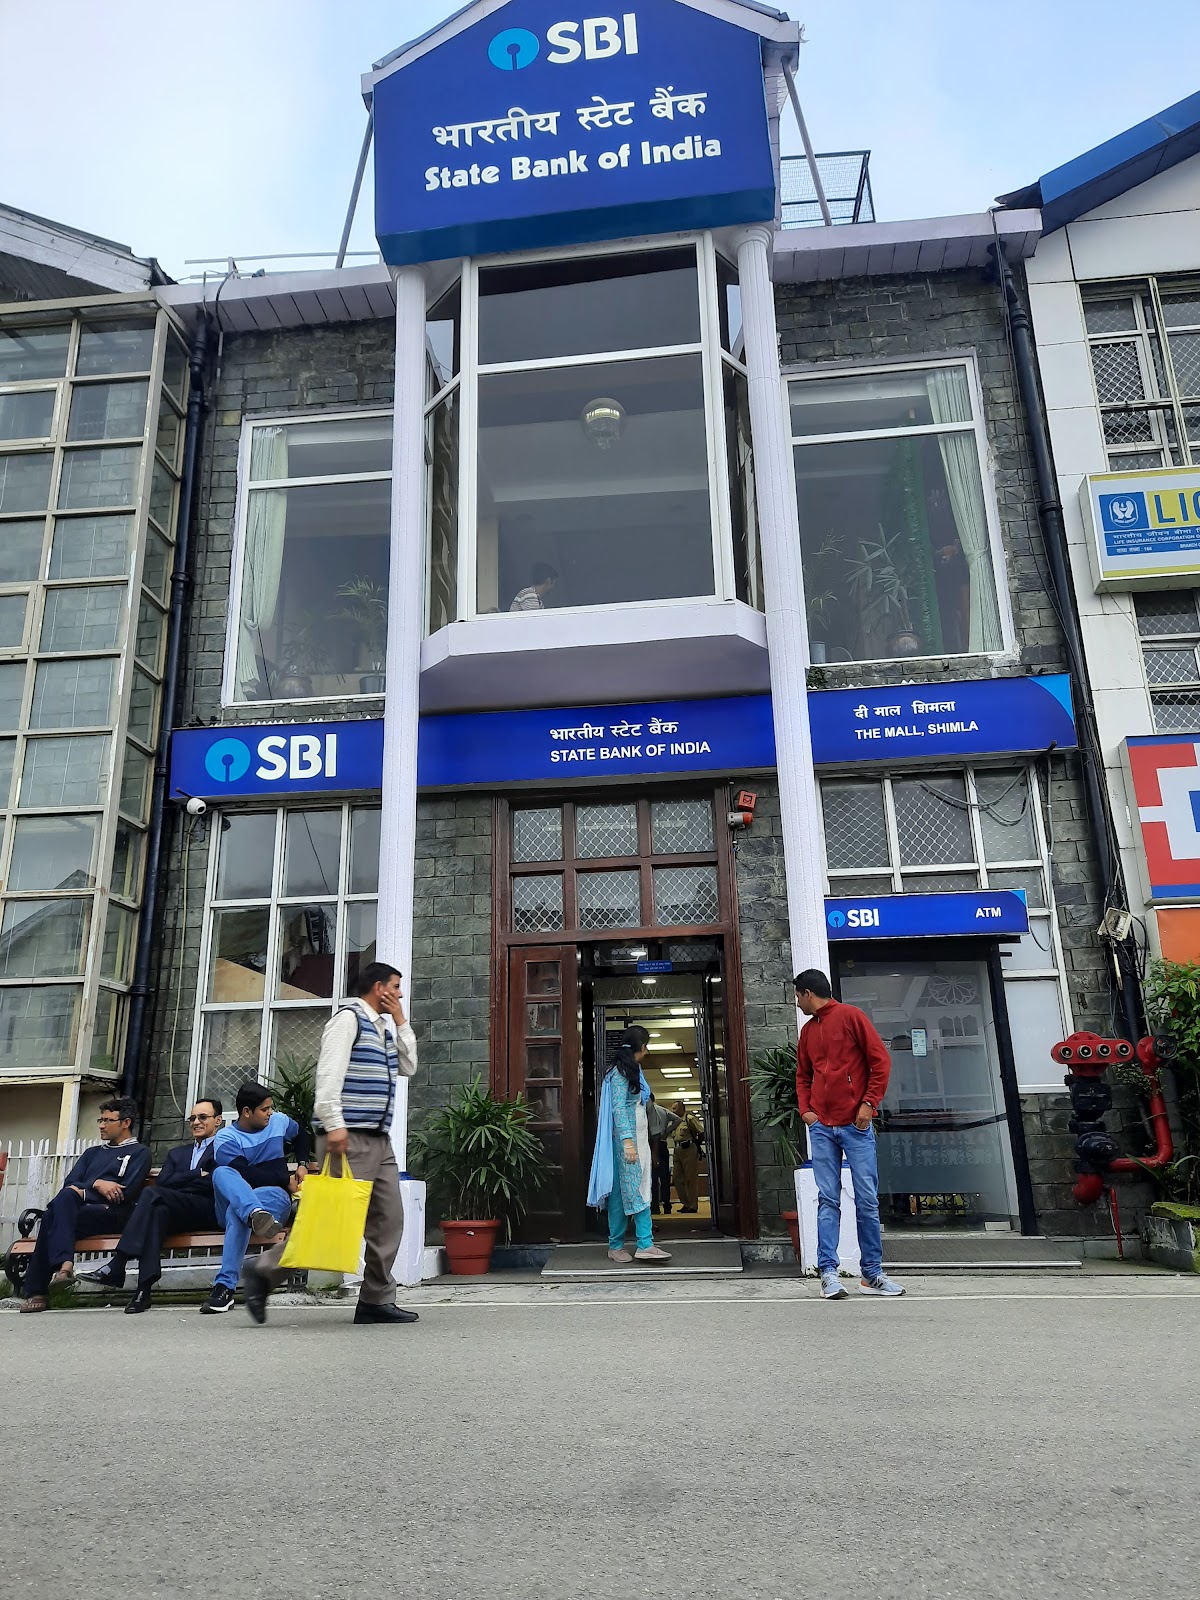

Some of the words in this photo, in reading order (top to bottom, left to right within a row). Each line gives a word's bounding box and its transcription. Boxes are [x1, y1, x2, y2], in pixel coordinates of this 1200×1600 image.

[546, 12, 639, 64] SBI
[431, 106, 561, 148] भारतीय
[576, 96, 635, 131] स्टेट
[649, 85, 708, 121] बैंक
[424, 163, 500, 191] State
[511, 150, 589, 181] Bank
[598, 143, 630, 170] of
[641, 135, 722, 165] India
[853, 704, 869, 719] दी
[873, 705, 901, 717] माल
[911, 700, 956, 715] शिमला
[550, 722, 604, 741] भारतीय
[609, 720, 642, 737] स्टेट
[647, 717, 679, 735] बैंक
[854, 728, 882, 740] THE
[884, 725, 925, 737] MALL,
[927, 720, 979, 735] SHIMLA
[255, 733, 337, 781] SBI
[550, 748, 596, 763] STATE
[599, 745, 643, 760] BANK
[645, 744, 667, 757] OF
[670, 740, 711, 755] INDIA
[847, 908, 880, 927] SBI
[975, 907, 1002, 918] ATM
